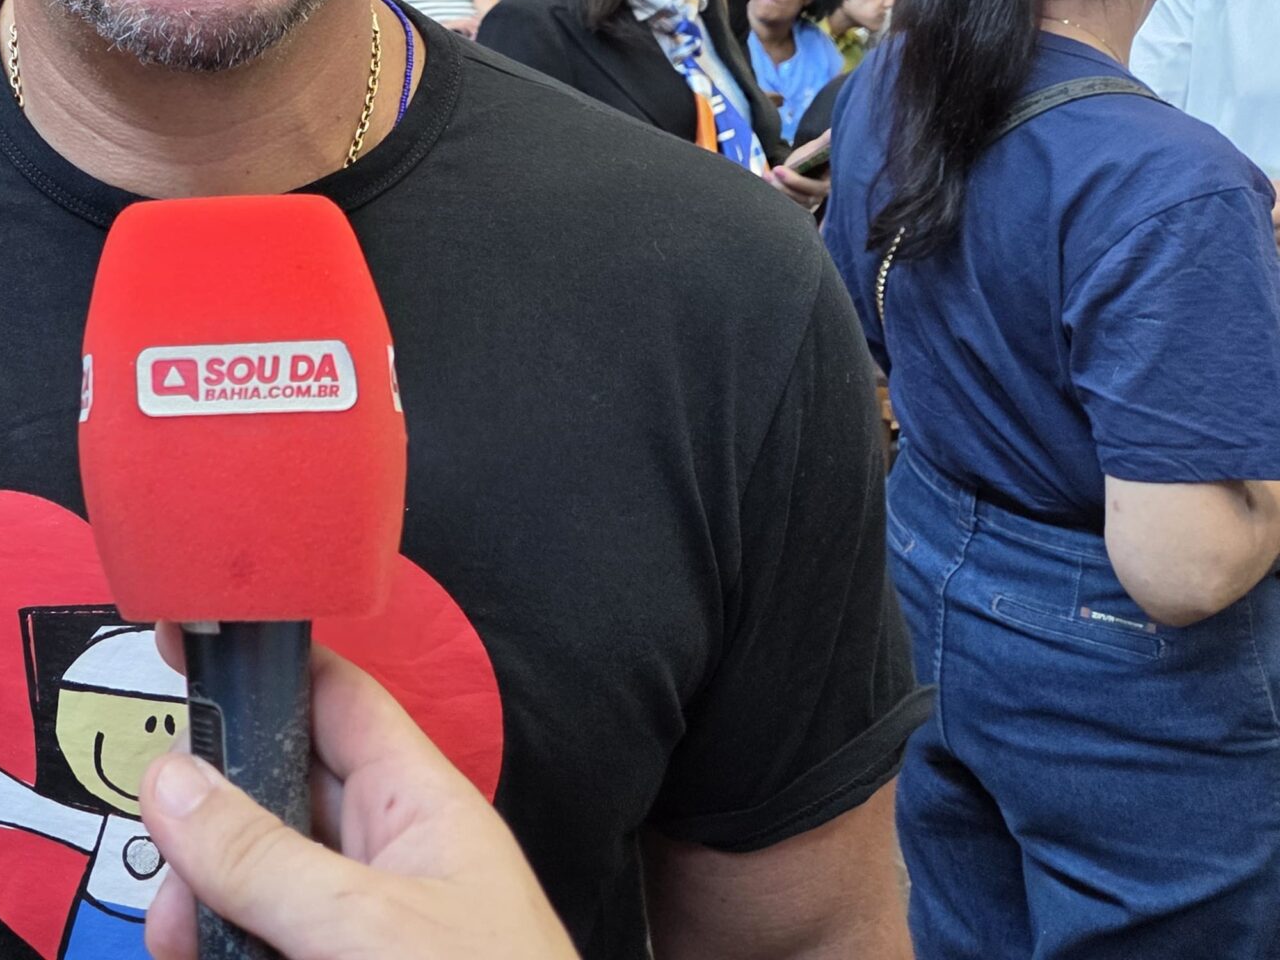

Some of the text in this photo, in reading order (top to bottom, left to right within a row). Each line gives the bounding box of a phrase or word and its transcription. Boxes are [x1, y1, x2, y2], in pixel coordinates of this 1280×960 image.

[204, 353, 339, 385] SOU DA
[204, 384, 340, 401] BAHIA.COM.BR
